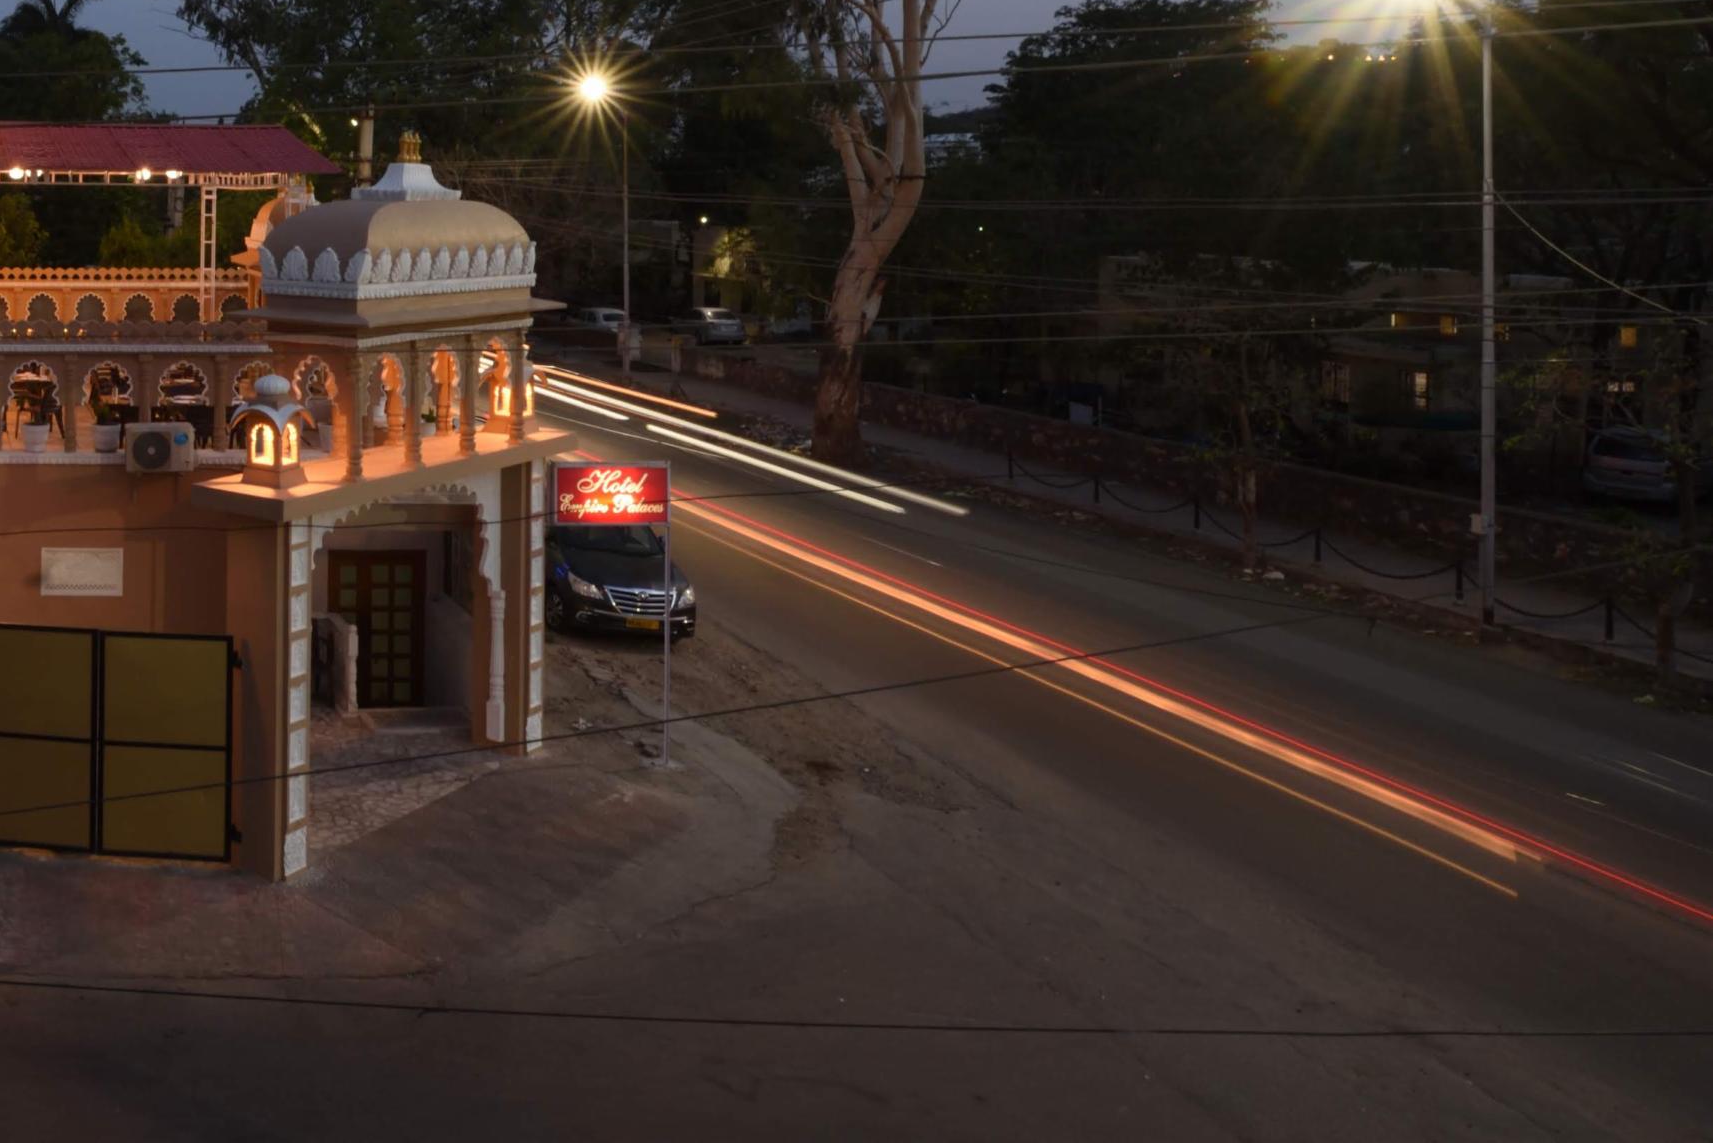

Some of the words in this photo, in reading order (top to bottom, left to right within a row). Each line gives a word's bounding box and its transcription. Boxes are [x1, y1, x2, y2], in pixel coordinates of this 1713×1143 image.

[577, 469, 648, 494] Hotel
[559, 493, 609, 519] Empire
[612, 493, 664, 514] Palaces
